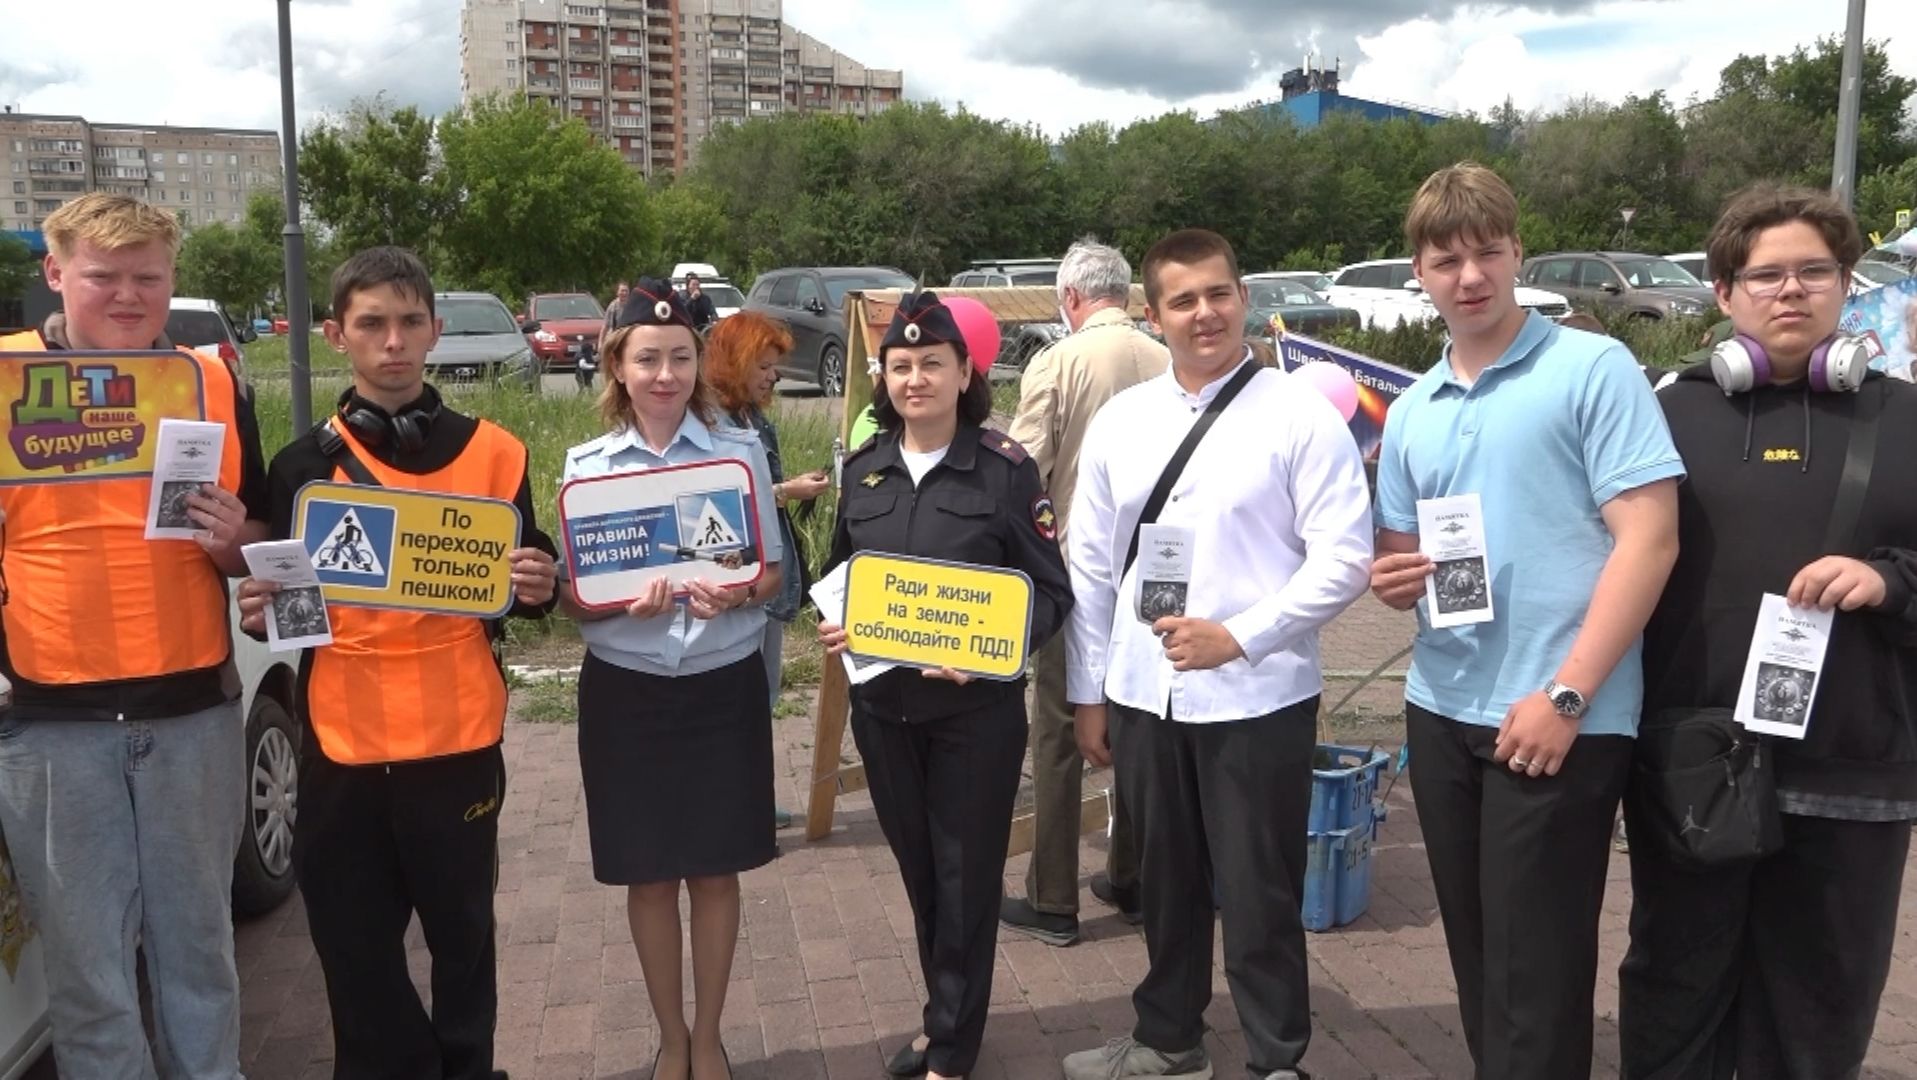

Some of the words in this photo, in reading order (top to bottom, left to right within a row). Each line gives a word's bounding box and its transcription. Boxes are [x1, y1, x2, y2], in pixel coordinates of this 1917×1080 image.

[89, 409, 136, 424] наше
[24, 427, 134, 458] будущее
[441, 506, 472, 530] По
[400, 533, 507, 562] переходу
[575, 526, 647, 546] ПРАВИЛА
[579, 544, 649, 565] ЖИЗНИ!
[412, 555, 490, 579] только
[401, 578, 495, 602] пешком!
[885, 573, 928, 597] Ради
[936, 584, 992, 605] жизни
[887, 603, 907, 618] на
[915, 606, 969, 627] земле
[853, 621, 961, 651] соблюдайте
[970, 634, 1015, 662] ПДД!
